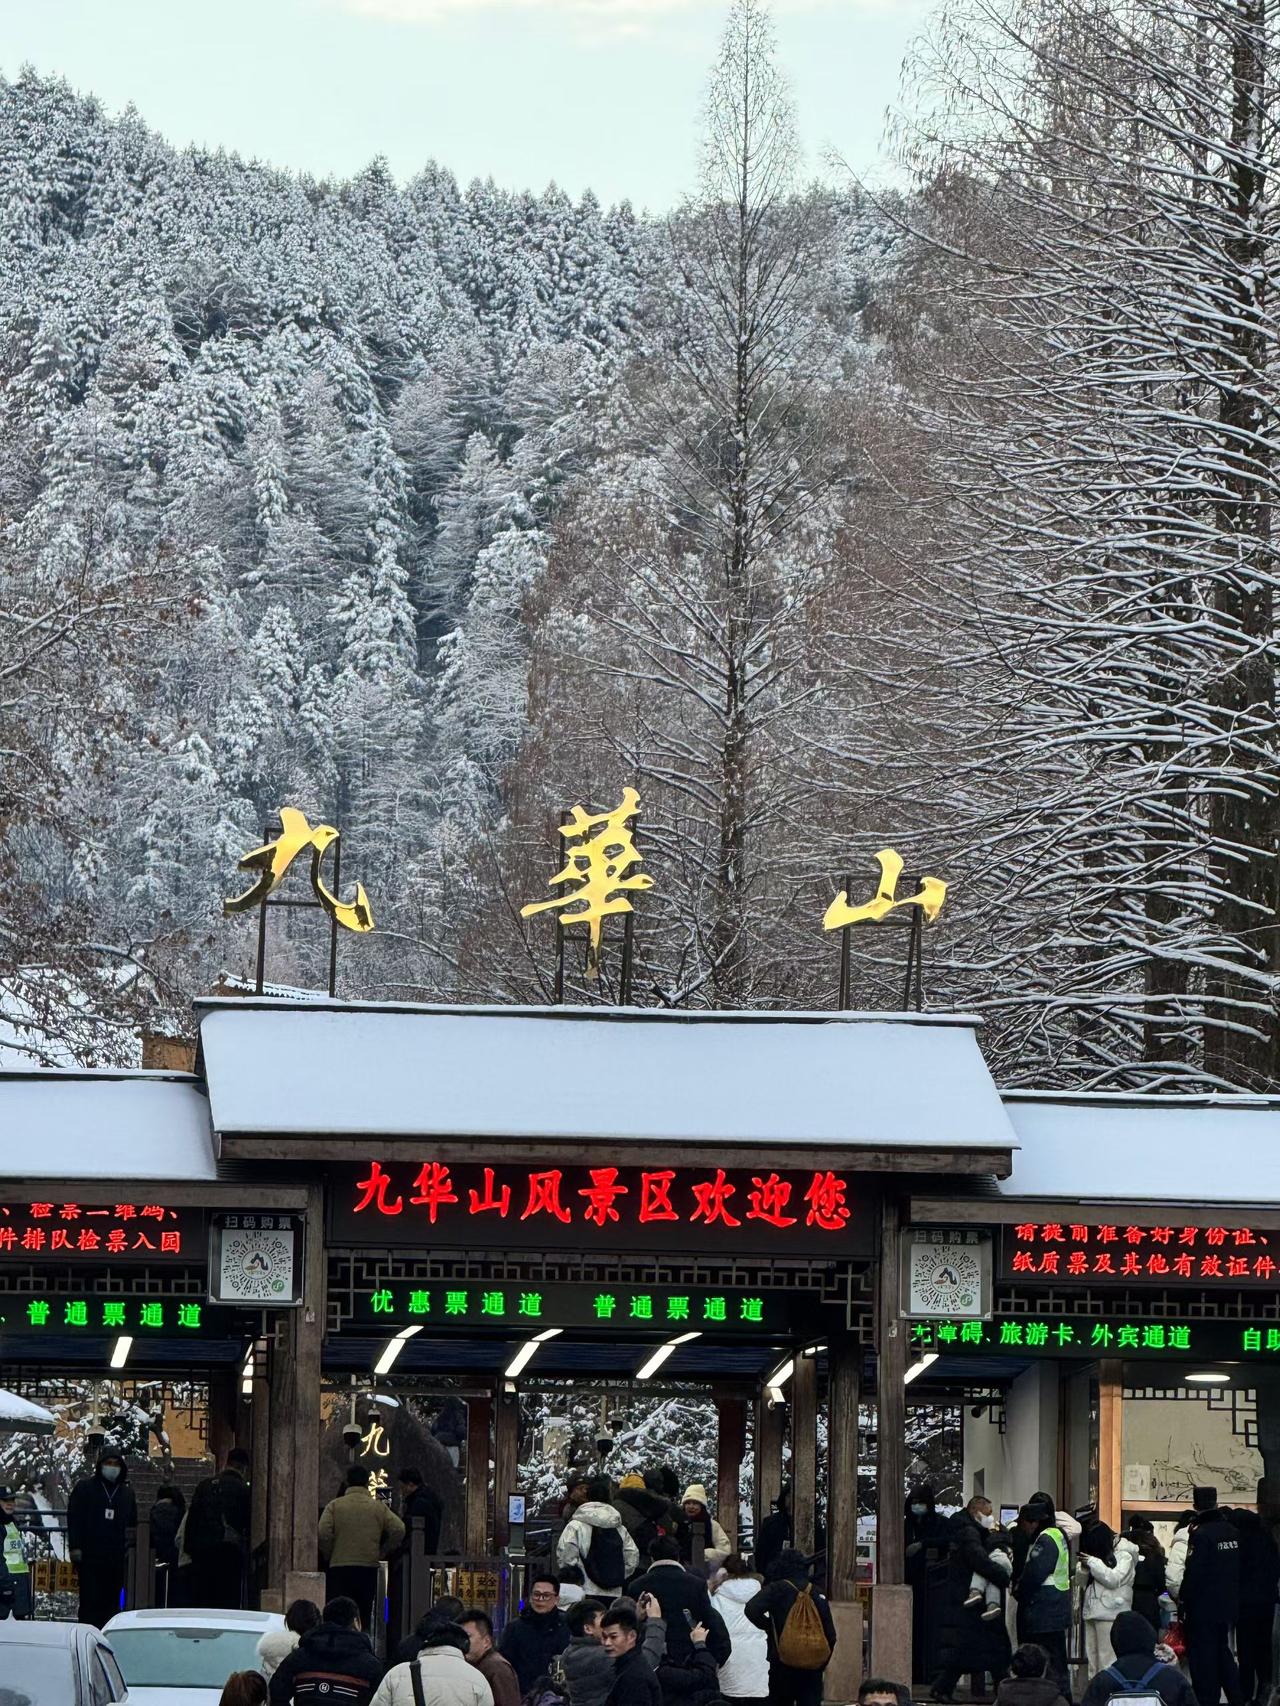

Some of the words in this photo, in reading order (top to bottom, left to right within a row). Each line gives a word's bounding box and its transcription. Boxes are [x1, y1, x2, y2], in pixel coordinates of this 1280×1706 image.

[223, 786, 948, 978] 九華山
[353, 1161, 851, 1230] 九华山风景区欢迎您
[224, 1215, 292, 1230] 扫码购票
[914, 1230, 979, 1244] 扫码购票
[0, 1227, 182, 1254] 件排队检票入园
[1012, 1250, 1280, 1280] 纸质票及其他有效证件
[370, 1289, 543, 1318] 优惠票通道
[592, 1294, 764, 1322] 普通票通道
[911, 1320, 1191, 1350] 无障碍、旅游卡、外宾通道
